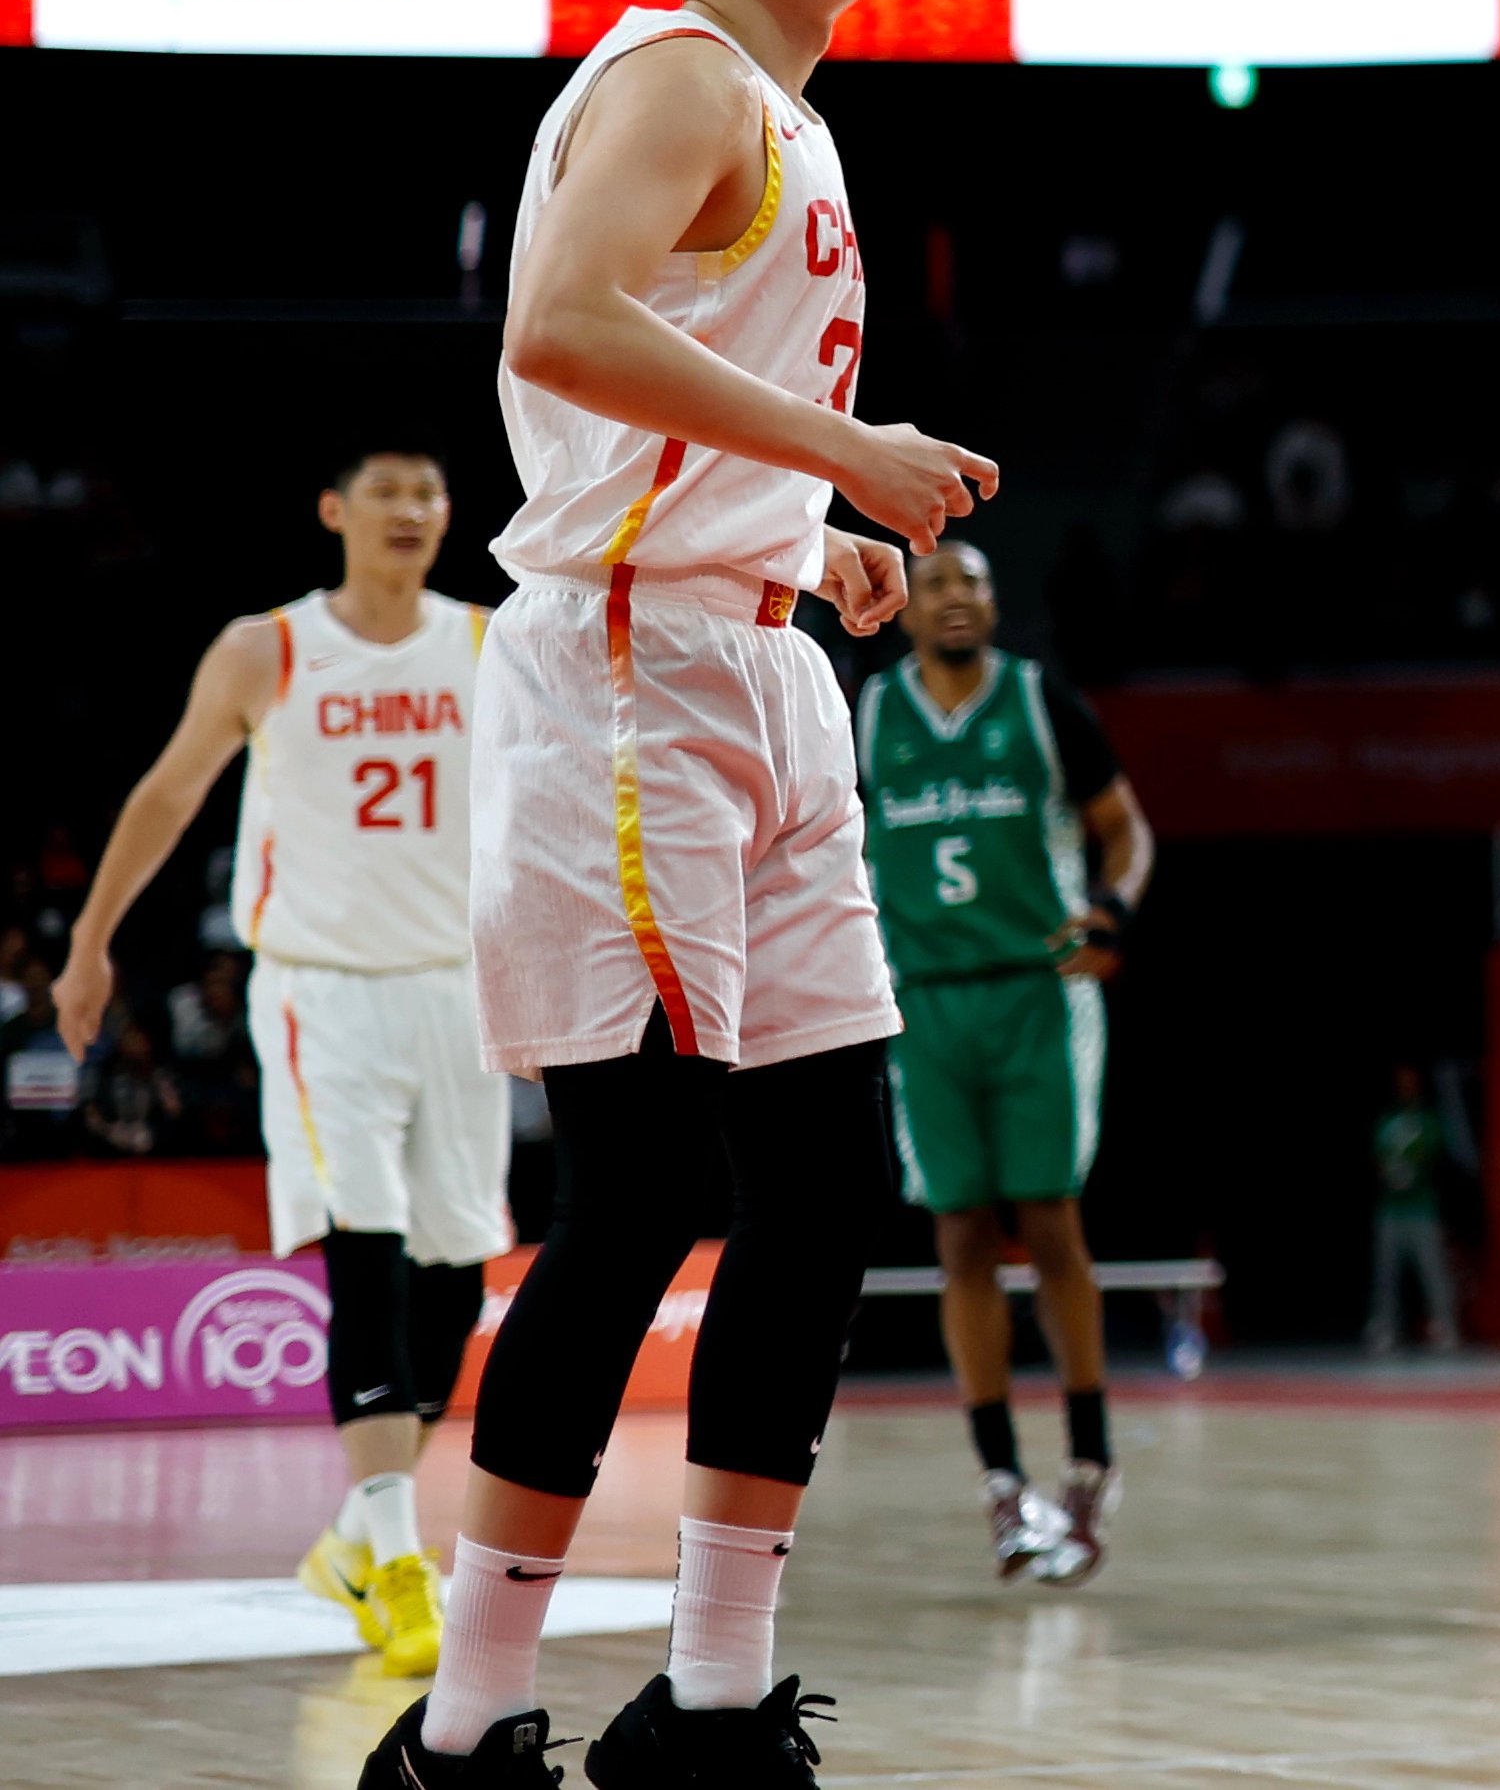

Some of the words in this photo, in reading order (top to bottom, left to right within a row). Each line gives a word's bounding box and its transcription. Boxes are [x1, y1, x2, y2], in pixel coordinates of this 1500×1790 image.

[317, 687, 466, 740] CHINA
[351, 756, 439, 832] 21
[934, 834, 979, 905] 5
